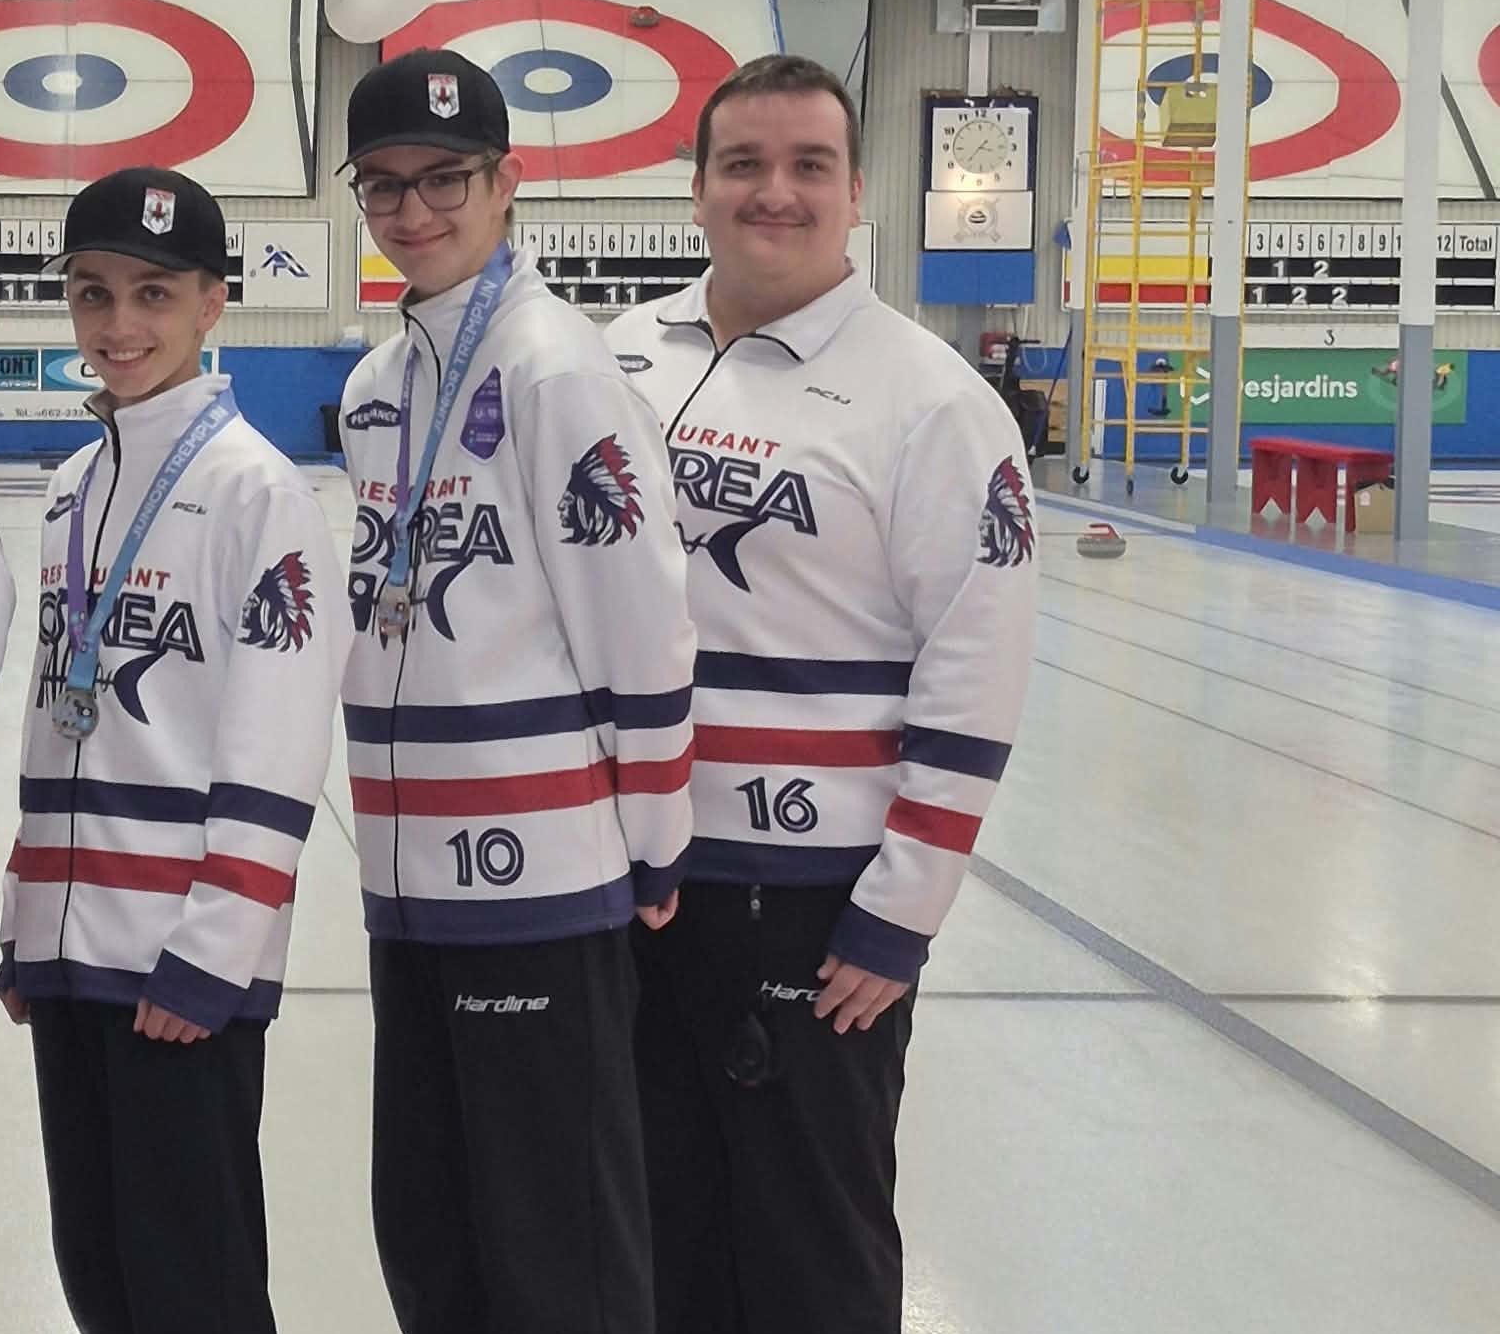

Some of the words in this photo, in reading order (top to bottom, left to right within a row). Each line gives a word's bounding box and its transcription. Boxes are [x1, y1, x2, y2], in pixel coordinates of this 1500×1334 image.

[7, 231, 14, 248] 3
[26, 231, 34, 248] 4
[47, 231, 55, 248] 5
[549, 234, 556, 252] 3
[568, 234, 575, 252] 4
[588, 234, 595, 252] 5
[608, 234, 615, 252] 6
[629, 234, 636, 252] 7
[649, 234, 656, 252] 8
[669, 234, 676, 252] 9
[687, 234, 700, 252] 10
[1256, 234, 1264, 251] 3
[1276, 234, 1284, 251] 4
[1297, 234, 1304, 251] 5
[1317, 234, 1325, 251] 6
[1338, 234, 1345, 251] 7
[1358, 234, 1365, 251] 8
[1378, 234, 1386, 251] 9
[1396, 235, 1401, 250] 1
[1437, 235, 1451, 251] 12
[1459, 235, 1492, 251] Total
[546, 259, 557, 277] 1
[586, 259, 597, 277] 1
[1272, 261, 1285, 277] 1
[1313, 261, 1329, 278] 2
[4, 283, 14, 299] 1
[23, 283, 34, 299] 1
[565, 286, 576, 303] 1
[605, 286, 617, 303] 1
[626, 286, 636, 303] 1
[1252, 288, 1265, 303] 1
[1292, 288, 1307, 304] 2
[1331, 288, 1347, 304] 2
[1323, 330, 1335, 345] 3
[434, 369, 461, 433] JUNIOR
[453, 279, 498, 364] TREMPLIN
[1241, 374, 1358, 403] esjardins
[677, 423, 781, 459] URANT
[132, 477, 169, 540] JUNIOR
[164, 405, 229, 476] TREMPLIN
[735, 776, 819, 834] 16
[446, 827, 524, 888] 10
[454, 994, 550, 1013] Hardline
